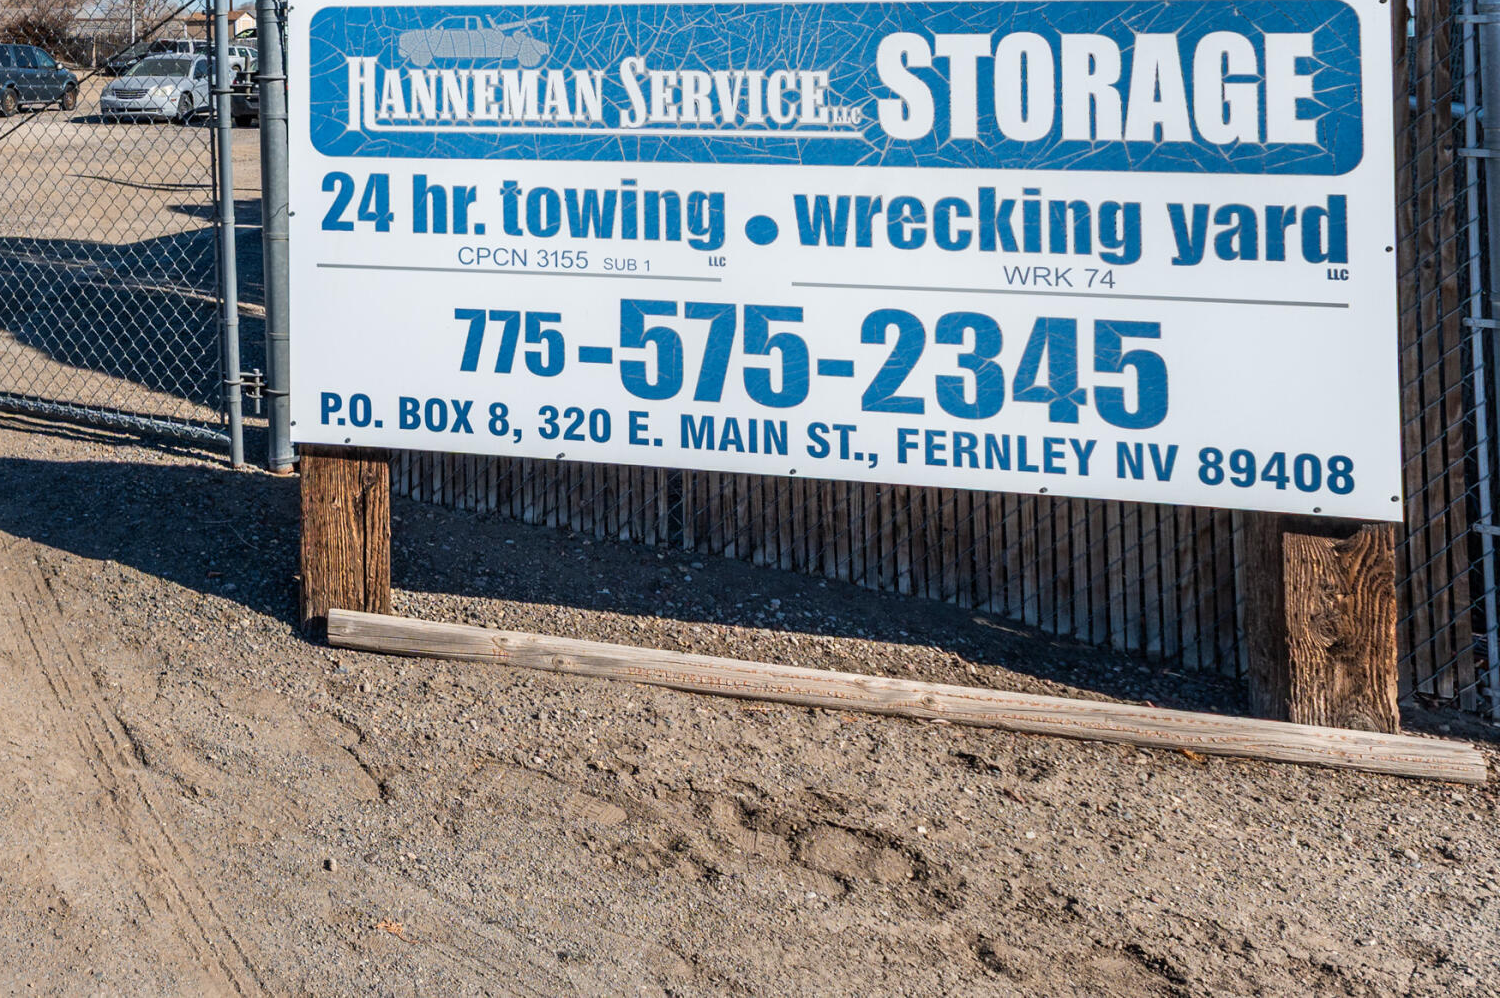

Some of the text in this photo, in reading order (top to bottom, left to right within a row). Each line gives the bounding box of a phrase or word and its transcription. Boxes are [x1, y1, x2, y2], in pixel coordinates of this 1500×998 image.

[346, 56, 862, 132] HANNEMAN SERVICE LLC
[876, 31, 1318, 145] STORAGE
[321, 171, 1349, 267] 24 hr. towing wrecking yard
[457, 246, 651, 272] CPCN 3155 SUB 1
[708, 256, 726, 268] LLC
[1003, 265, 1116, 290] WRK 74
[1326, 268, 1349, 281] LLC
[454, 298, 1168, 429] 775-575-2345
[320, 391, 1356, 495] P.O. BOX 8, 320 E. MAIN ST., FERNLEY NV 89408
